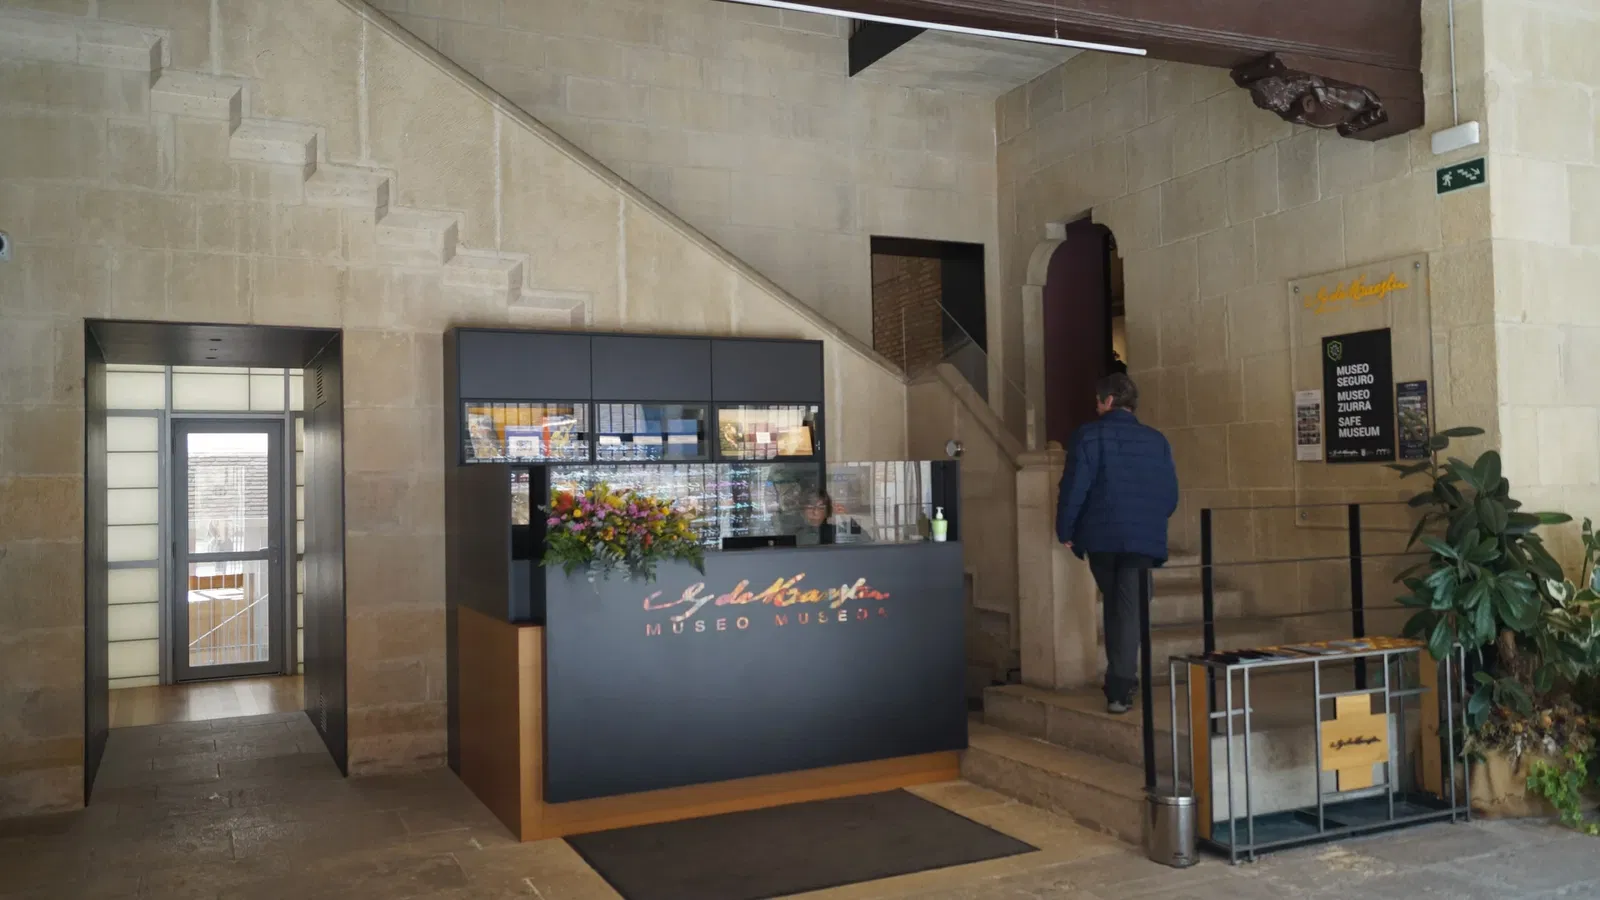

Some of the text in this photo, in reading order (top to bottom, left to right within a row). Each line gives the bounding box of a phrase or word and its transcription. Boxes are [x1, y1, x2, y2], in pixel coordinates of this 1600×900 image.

[1337, 363, 1369, 376] MUSEO
[1337, 374, 1374, 387] SEGURO
[1338, 389, 1370, 401] MUSEO
[1338, 400, 1372, 413] ZIURRA
[1339, 416, 1361, 427] SAFE
[1339, 426, 1380, 438] MUSEUM
[646, 616, 749, 637] MUSEO
